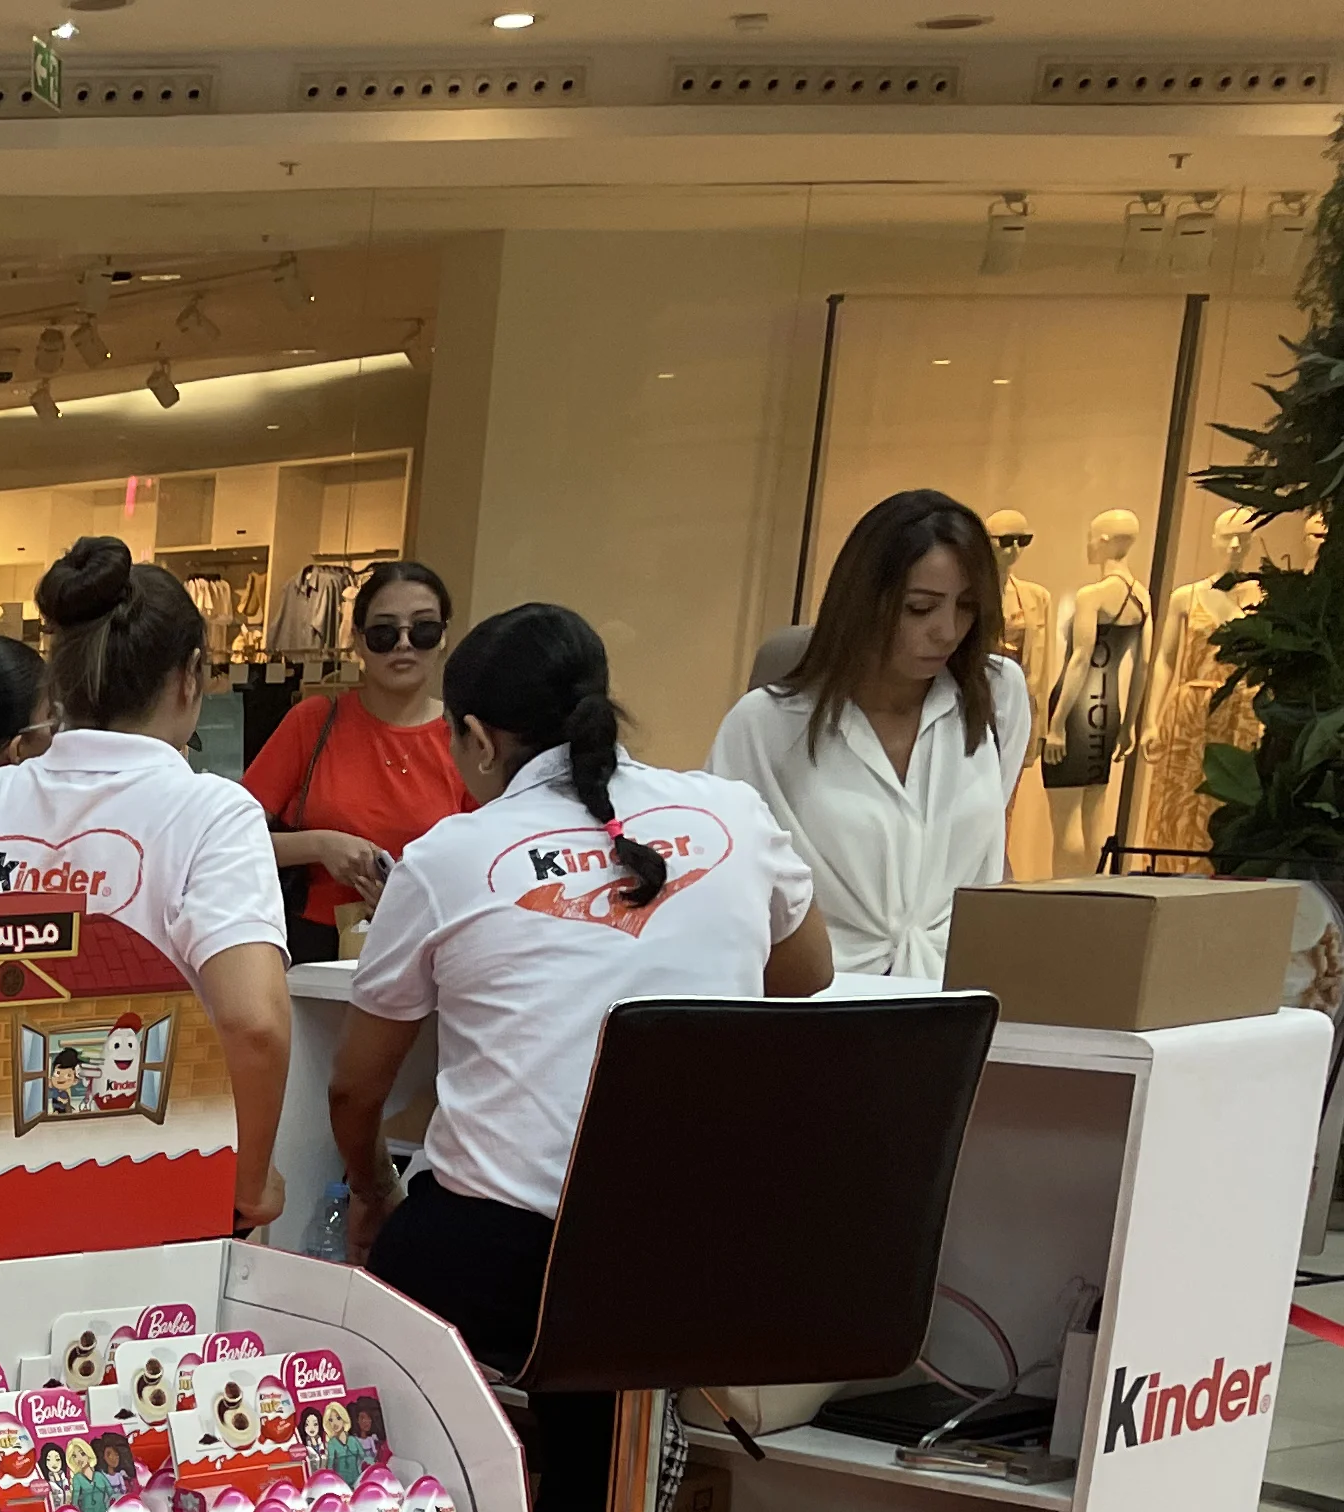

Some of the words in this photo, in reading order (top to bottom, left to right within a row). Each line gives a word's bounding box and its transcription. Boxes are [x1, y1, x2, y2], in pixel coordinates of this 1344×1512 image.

[528, 835, 691, 880] Kiner
[106, 1078, 137, 1092] Kinder
[148, 1310, 194, 1338] Barbie
[215, 1337, 262, 1362] Barbie
[293, 1357, 340, 1387] Barbie
[28, 1395, 82, 1423] Barbie
[1103, 1357, 1272, 1455] Kinder
